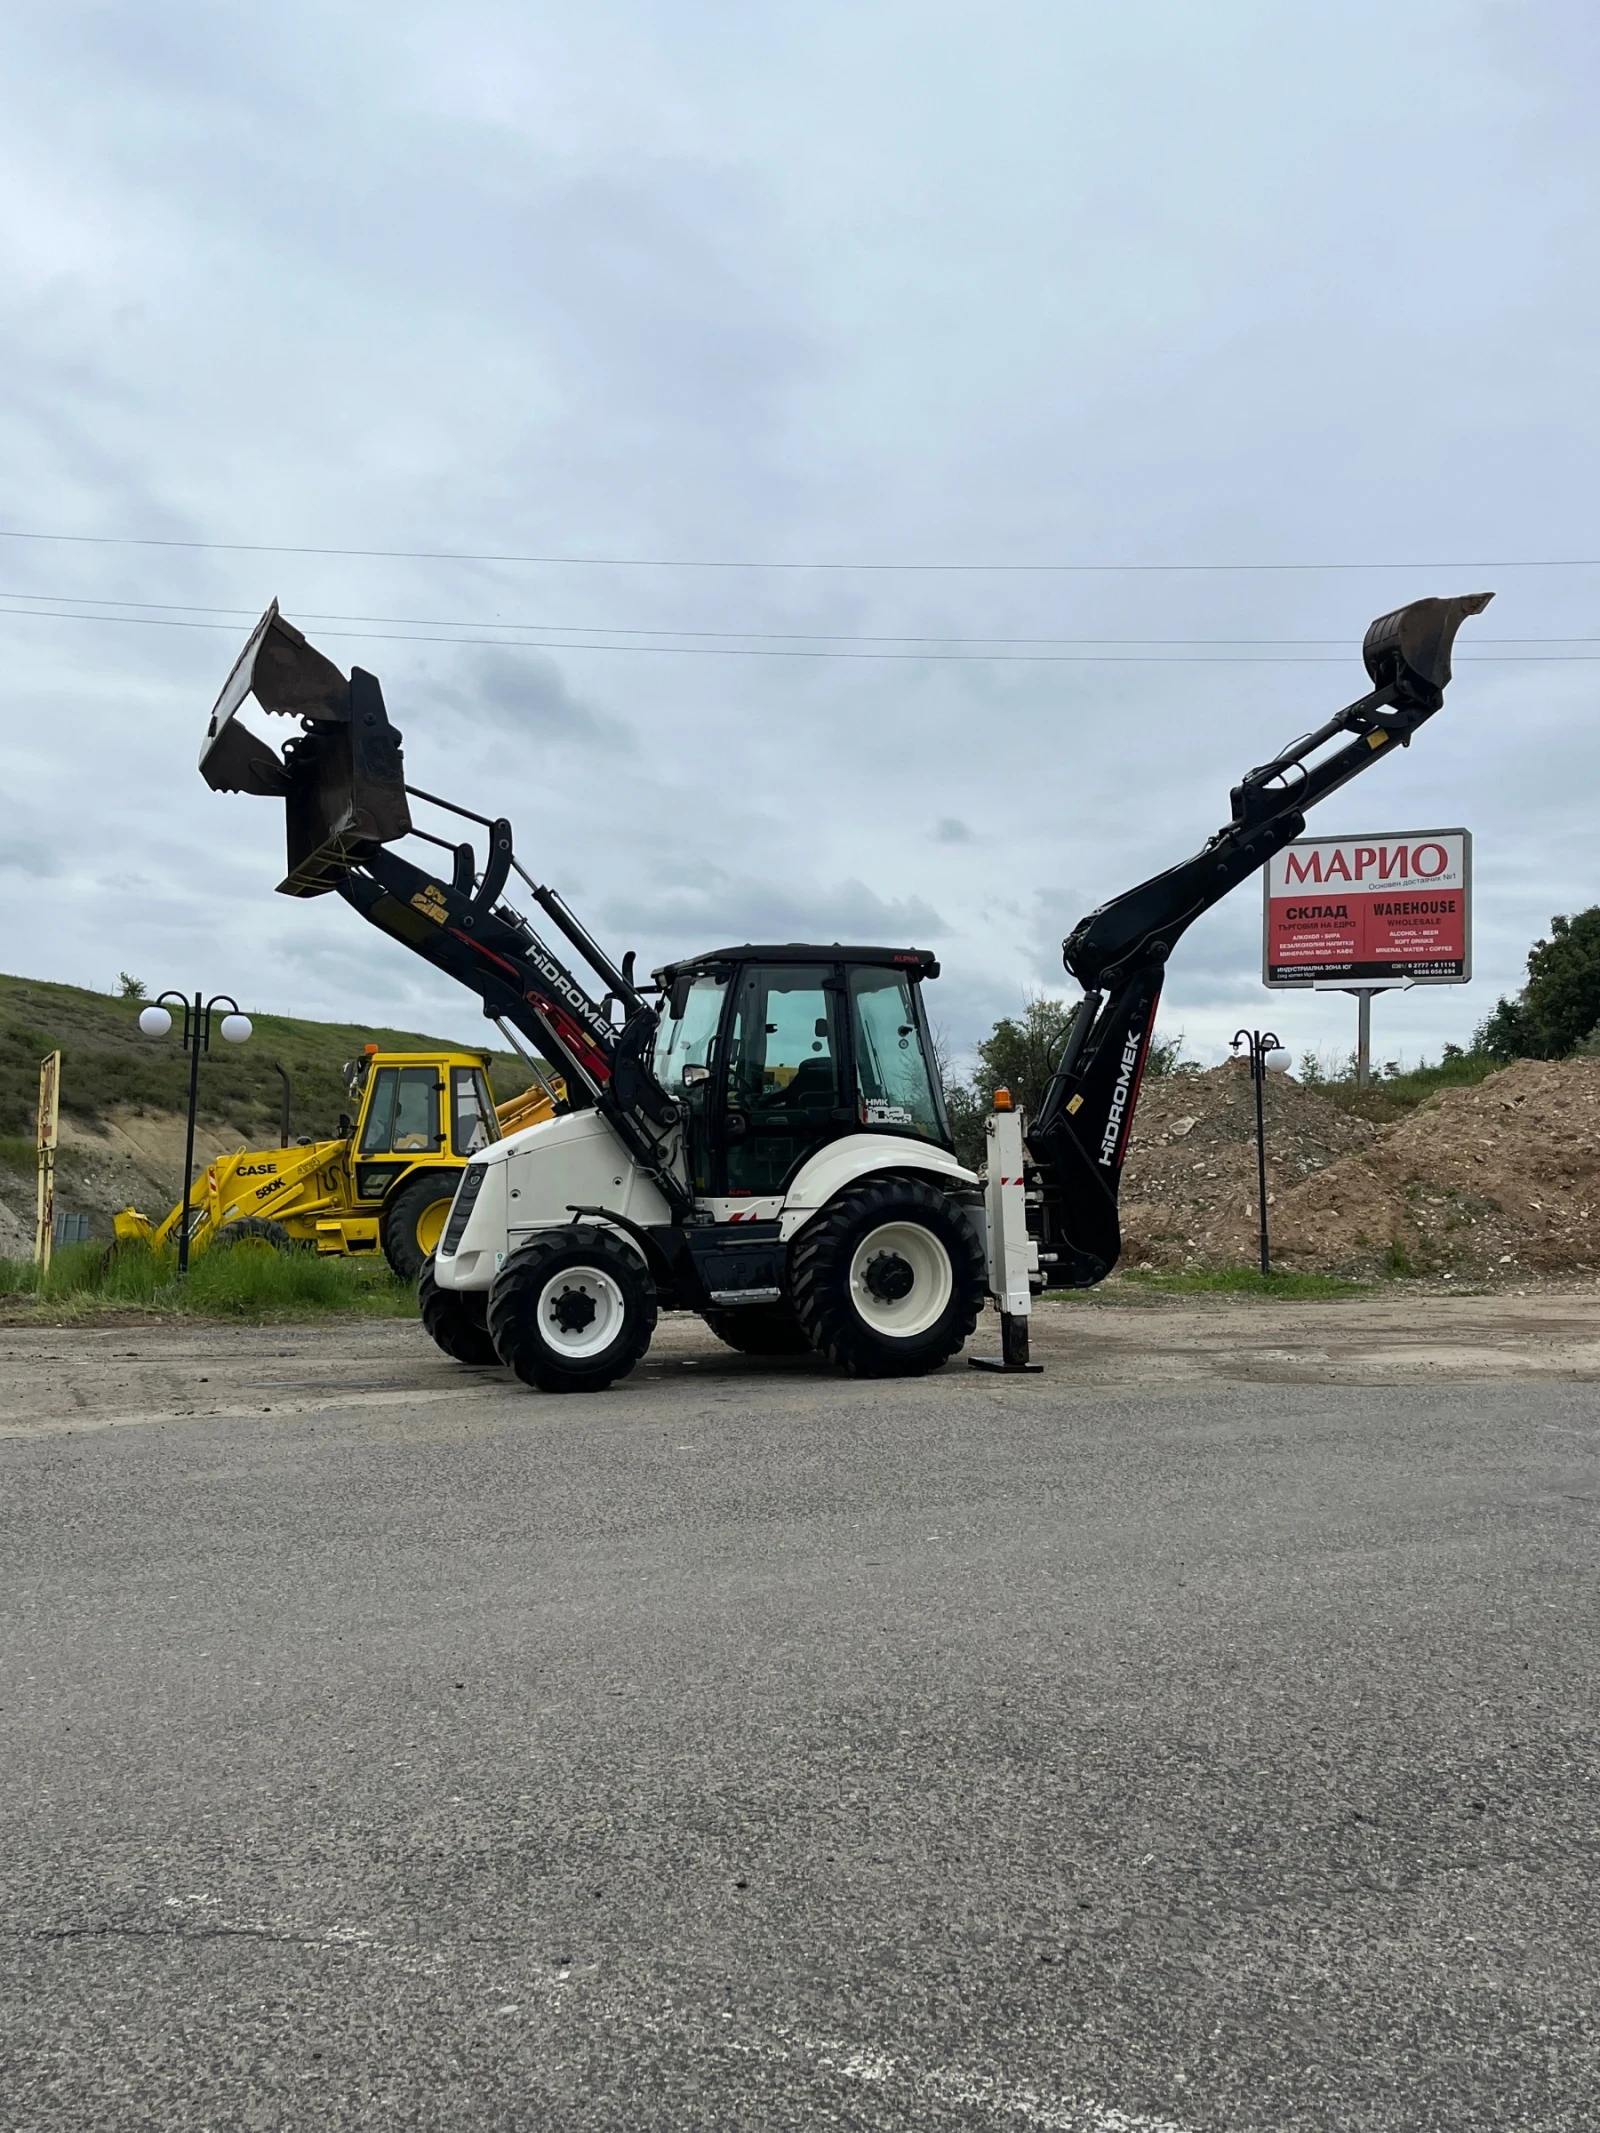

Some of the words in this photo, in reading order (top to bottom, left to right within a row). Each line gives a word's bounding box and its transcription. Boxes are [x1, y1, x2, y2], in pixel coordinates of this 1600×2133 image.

[1284, 843, 1448, 885] МАРИО
[1368, 881, 1401, 891] Основен
[1403, 876, 1441, 888] доставчик
[1443, 873, 1456, 882] №1
[1286, 905, 1348, 920] СКЛАД
[1373, 901, 1456, 916] WAREHOUSE
[1278, 922, 1319, 931] ТЪРГОВИЯ
[1333, 921, 1356, 929] ЕДРО
[1387, 918, 1441, 926] WHOLESALE
[894, 955, 919, 963] ALPHA
[1277, 965, 1324, 973] ИНДУСТРИАЛНА
[865, 1098, 888, 1106] HMK
[236, 1163, 277, 1177] CASE
[255, 1177, 286, 1200] 580K
